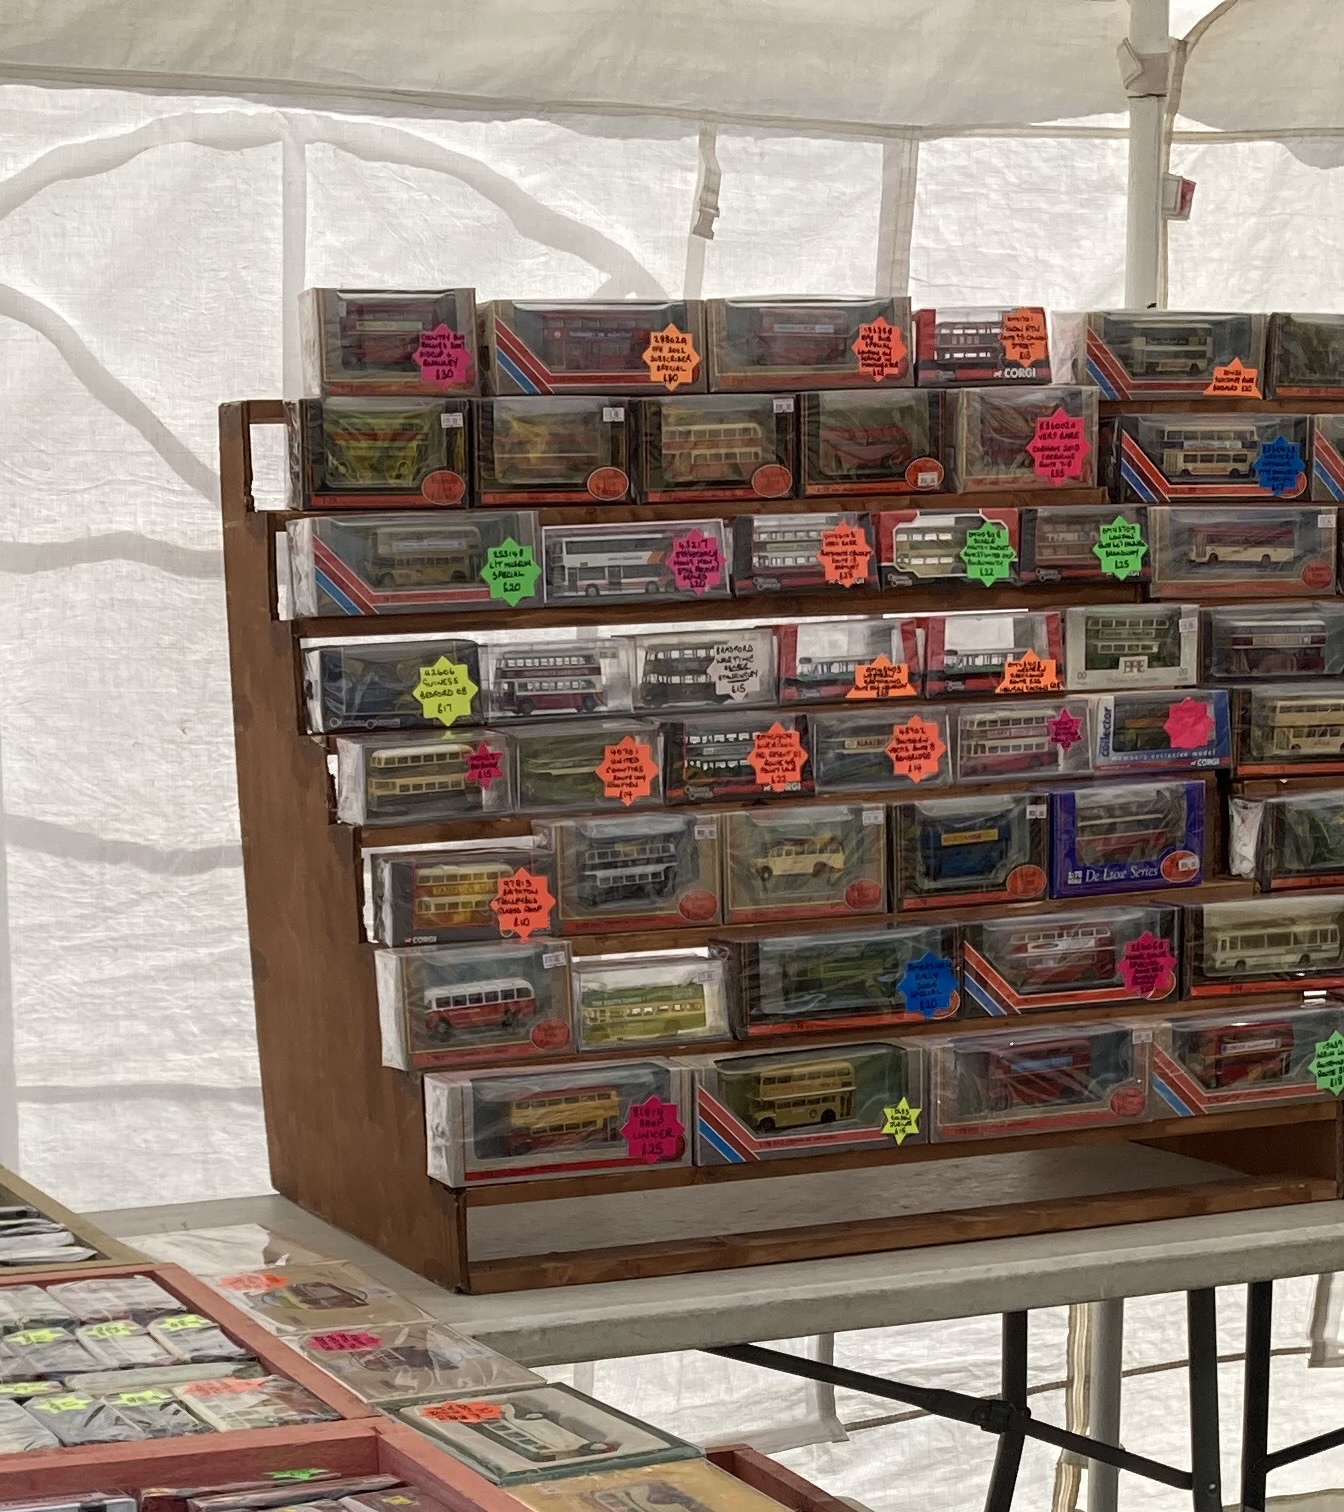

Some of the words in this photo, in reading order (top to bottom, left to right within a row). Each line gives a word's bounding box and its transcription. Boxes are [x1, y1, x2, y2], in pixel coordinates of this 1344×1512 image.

[1004, 368, 1036, 378] CORGI
[1100, 706, 1113, 758] collector
[1085, 869, 1099, 881] De
[1130, 865, 1158, 878] Series
